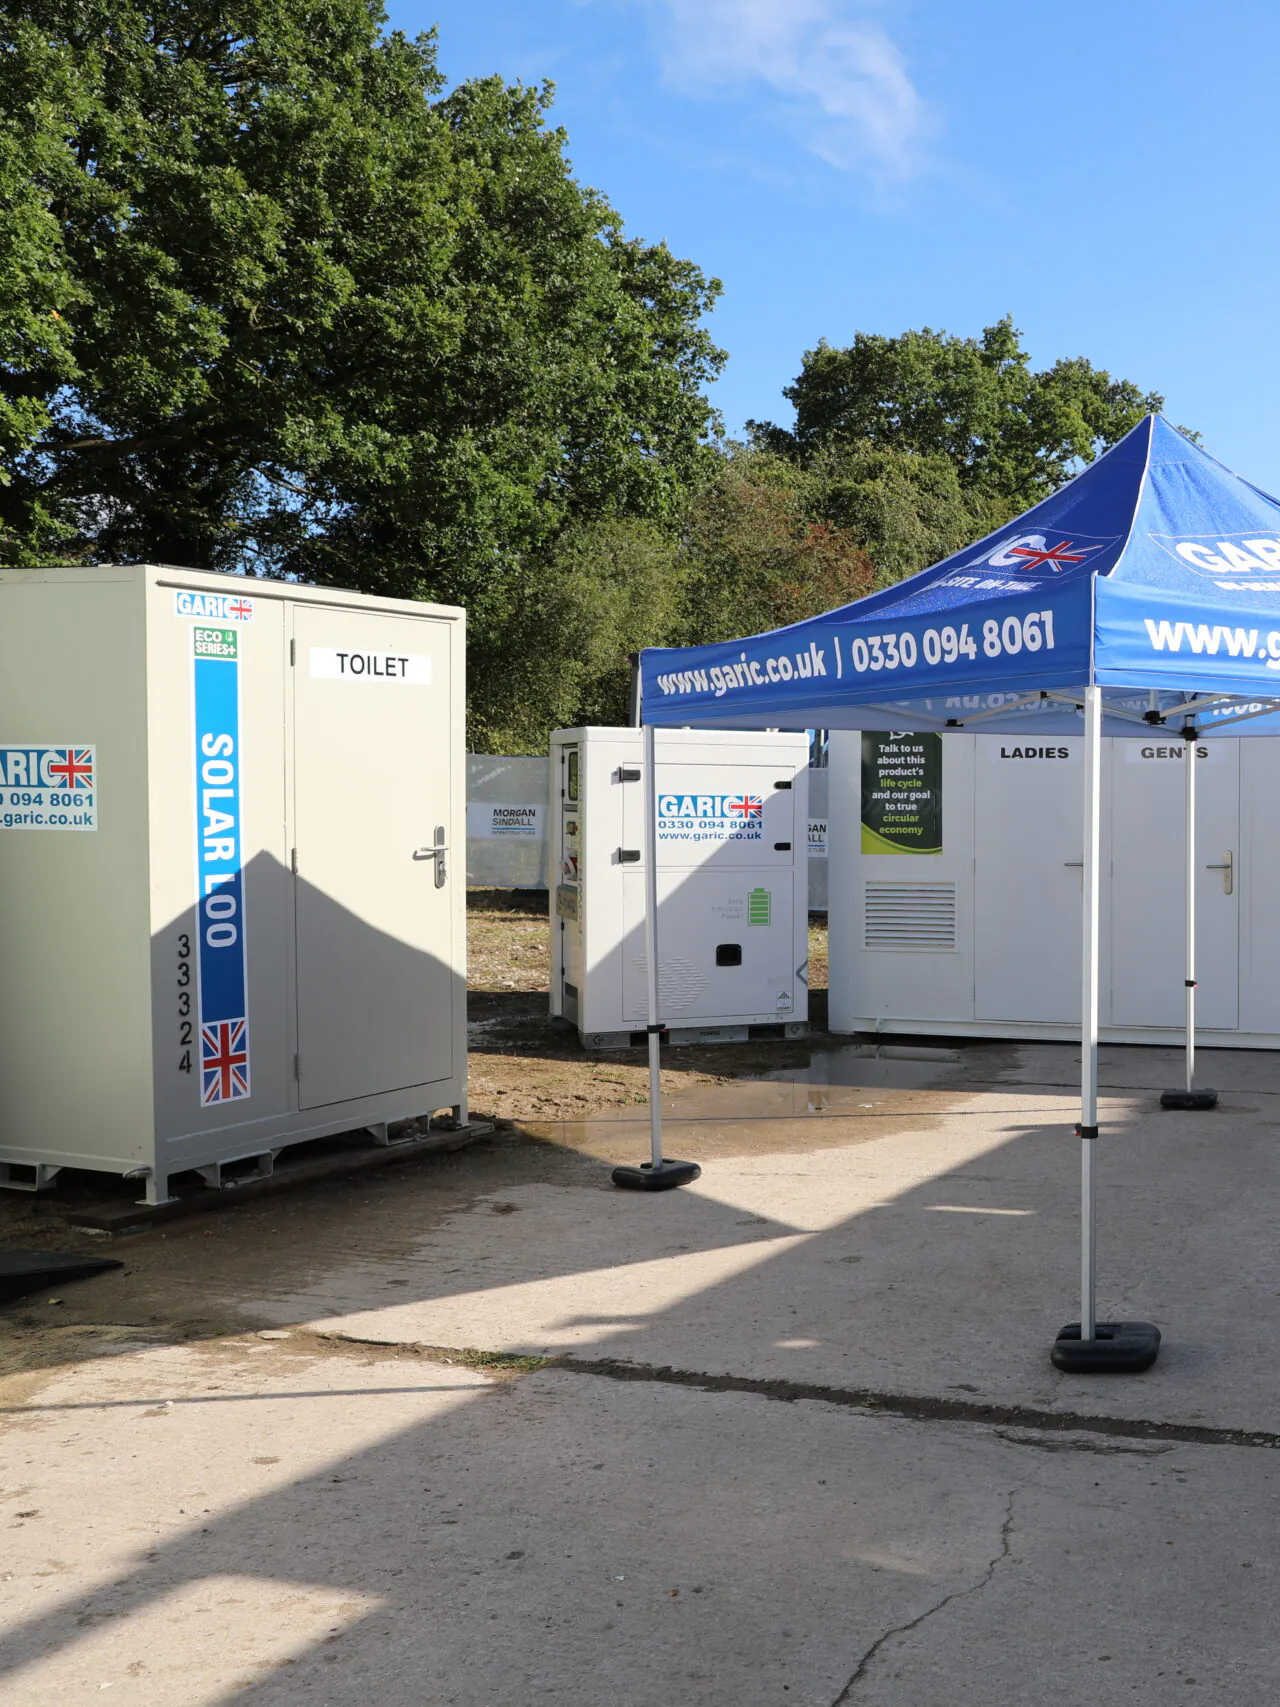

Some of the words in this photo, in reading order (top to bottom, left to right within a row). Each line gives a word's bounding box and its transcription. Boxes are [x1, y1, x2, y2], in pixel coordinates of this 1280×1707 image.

[177, 593, 238, 619] GARIC
[195, 629, 222, 642] ECO
[656, 642, 828, 697] www.garic.co.uk
[852, 632, 918, 672] 0330
[923, 623, 977, 665] 094
[983, 610, 1055, 658] 8061
[336, 653, 409, 677] TOILET
[879, 744, 899, 753] Talk
[900, 745, 911, 753] to
[912, 745, 924, 753] us
[1000, 747, 1069, 759] LADIES
[1141, 747, 1209, 759] GENS
[877, 756, 905, 764] about
[906, 755, 925, 764] this
[0, 751, 64, 787] RIC
[880, 779, 896, 787] life
[897, 779, 922, 789] cycle
[10, 792, 44, 806] 094
[49, 793, 93, 807] 8061
[201, 733, 236, 861] SOLAR
[872, 790, 890, 799] and
[891, 791, 908, 799] our
[909, 790, 931, 801] goal
[493, 808, 536, 817] MORGAN
[660, 795, 742, 818] GARIC
[885, 802, 896, 811] to
[897, 803, 917, 811] true
[0, 810, 94, 827] .garic.co.uk
[492, 818, 534, 826] SINDALL
[882, 814, 919, 822] circular
[658, 820, 694, 829] 0330
[698, 820, 725, 829] 094
[729, 821, 763, 829] 8061
[658, 831, 762, 842] www.garic.co.uk
[879, 826, 923, 836] economy
[205, 873, 237, 948] LOO
